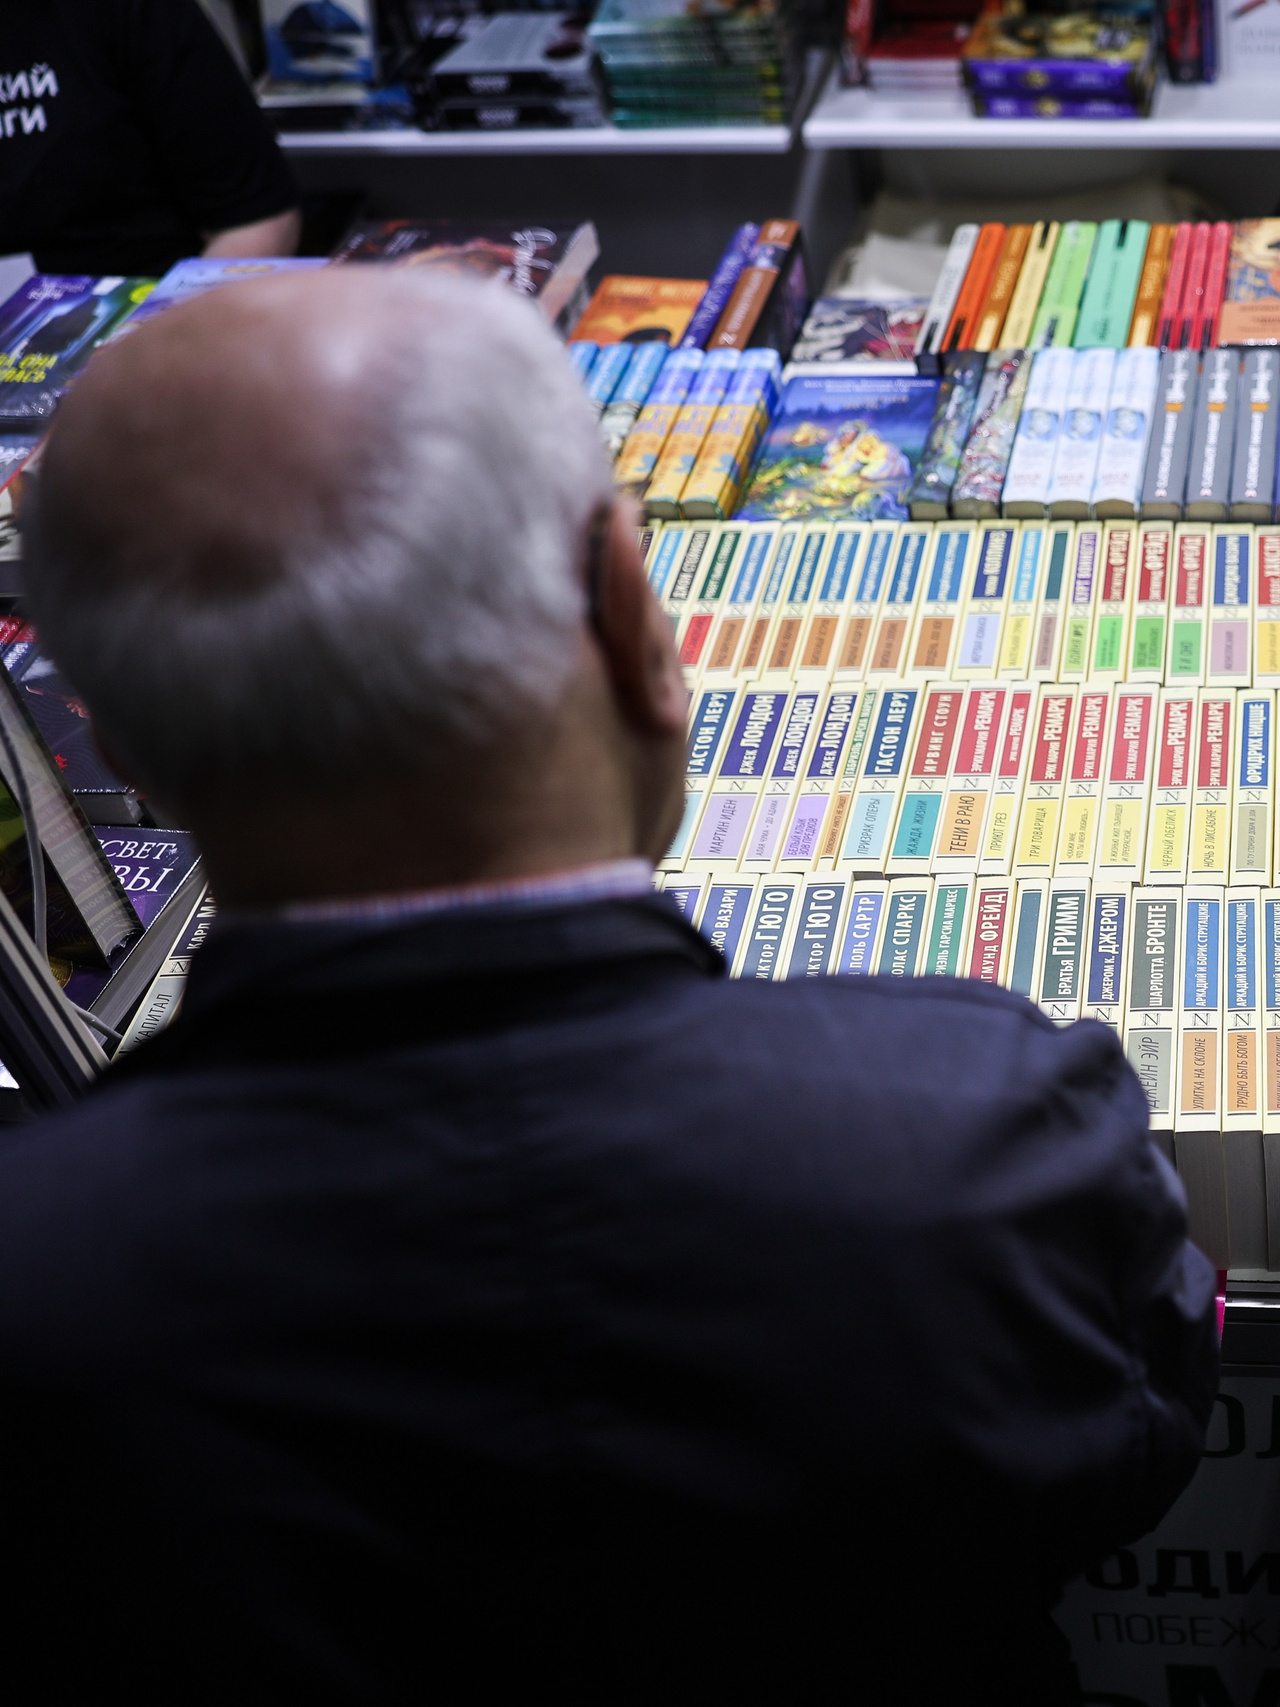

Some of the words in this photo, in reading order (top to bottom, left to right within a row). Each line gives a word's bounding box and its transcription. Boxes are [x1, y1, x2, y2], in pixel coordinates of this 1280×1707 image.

[740, 694, 776, 748] ЛОНДОН
[783, 698, 815, 747] ЛОНДОН
[820, 695, 853, 748] ЛОНДОН
[887, 692, 909, 723] ЛЕРУ
[974, 691, 997, 730] РЕМАРК
[1043, 698, 1067, 741] РЕМАРК
[1082, 697, 1103, 738] РЕМАРК
[1123, 698, 1144, 739] РЕМАРК
[1207, 703, 1224, 743] РЕМАРК
[1248, 703, 1267, 736] НИЦШЕ
[687, 726, 716, 773] ГАСТОН
[703, 693, 727, 723] ЛЕРУ
[923, 731, 945, 773] ИРВИНГ
[934, 694, 953, 727] СТОУН
[1167, 702, 1188, 746] РЕМАРК
[739, 750, 758, 774] ДЖЕК
[783, 749, 799, 772] ДЖЕК
[820, 750, 837, 775] ДЖЕК
[875, 726, 901, 773] ГАСТОН
[1174, 746, 1185, 768] МАРИЯ
[1211, 744, 1222, 767] МАРИЯ
[1246, 738, 1265, 783] ФРИДРИХ
[1210, 768, 1221, 786] ЭРИХ
[865, 798, 880, 821] ОПЕРЫ
[914, 800, 927, 825] ЖИЗНИ
[957, 795, 975, 818] РАЮ
[995, 812, 1007, 827] ГРЕЗ
[709, 822, 729, 855] МАРТИН
[722, 799, 737, 821] ИДЕН
[857, 823, 874, 854] ПРИЗРАК
[950, 827, 968, 852] ТЕНИ
[990, 828, 1004, 851] ПРИЮТ
[1031, 807, 1047, 843] ТОВАРИЩА
[1165, 809, 1176, 838] ОБЕЛИСК
[1205, 809, 1217, 843] ЛИССАБОНЕ
[99, 839, 176, 860] СВЕТ
[907, 827, 922, 855] ЖАЖДА
[1029, 844, 1040, 858] ТРИ
[1163, 839, 1174, 867] ЧЕРНЫЙ
[1204, 851, 1214, 868] НОЧЬ
[113, 865, 173, 892] ВЫ
[715, 889, 739, 928] ВАЗАРИ
[755, 891, 789, 940] ГЮГО
[803, 889, 836, 940] ГЮГО
[852, 897, 876, 938] САРТР
[943, 889, 958, 919] МАРКЕС
[979, 893, 1007, 941] ФРЕЙД
[187, 922, 211, 950] КАРЛ
[892, 896, 917, 945] СПАРКС
[939, 920, 953, 948] ГАРСИА
[1052, 896, 1080, 956] ГРИММ
[1098, 898, 1119, 954] ДЖЕРОМ
[1146, 904, 1167, 954] БРОНТЕ
[1197, 902, 1210, 942] СТРУГАЦКИЕ
[1236, 902, 1248, 942] СТРУГАЦКИЕ
[849, 941, 866, 967] ПОЛЬ
[1197, 944, 1208, 966] БОРИС
[1236, 943, 1246, 966] БОРИС
[1058, 959, 1075, 995] БРАТЬЯ
[1101, 965, 1115, 1001] ДЖЕРОМ
[1149, 957, 1165, 1006] ШАРЛОТТА
[1195, 974, 1209, 1007] АРКАДИЙ
[1236, 974, 1249, 1007] АРКАДИЙ
[133, 993, 172, 1045] КАПИТАЛ
[1138, 1036, 1160, 1060] ЭЙР
[1194, 1037, 1206, 1067] СКЛОНЕ
[1237, 1035, 1248, 1059] БОГОМ
[1193, 1068, 1205, 1079] НА
[1237, 1061, 1248, 1079] БЫТЬ
[1193, 1081, 1205, 1109] УЛИТКА
[1237, 1081, 1250, 1108] ТРУДНО
